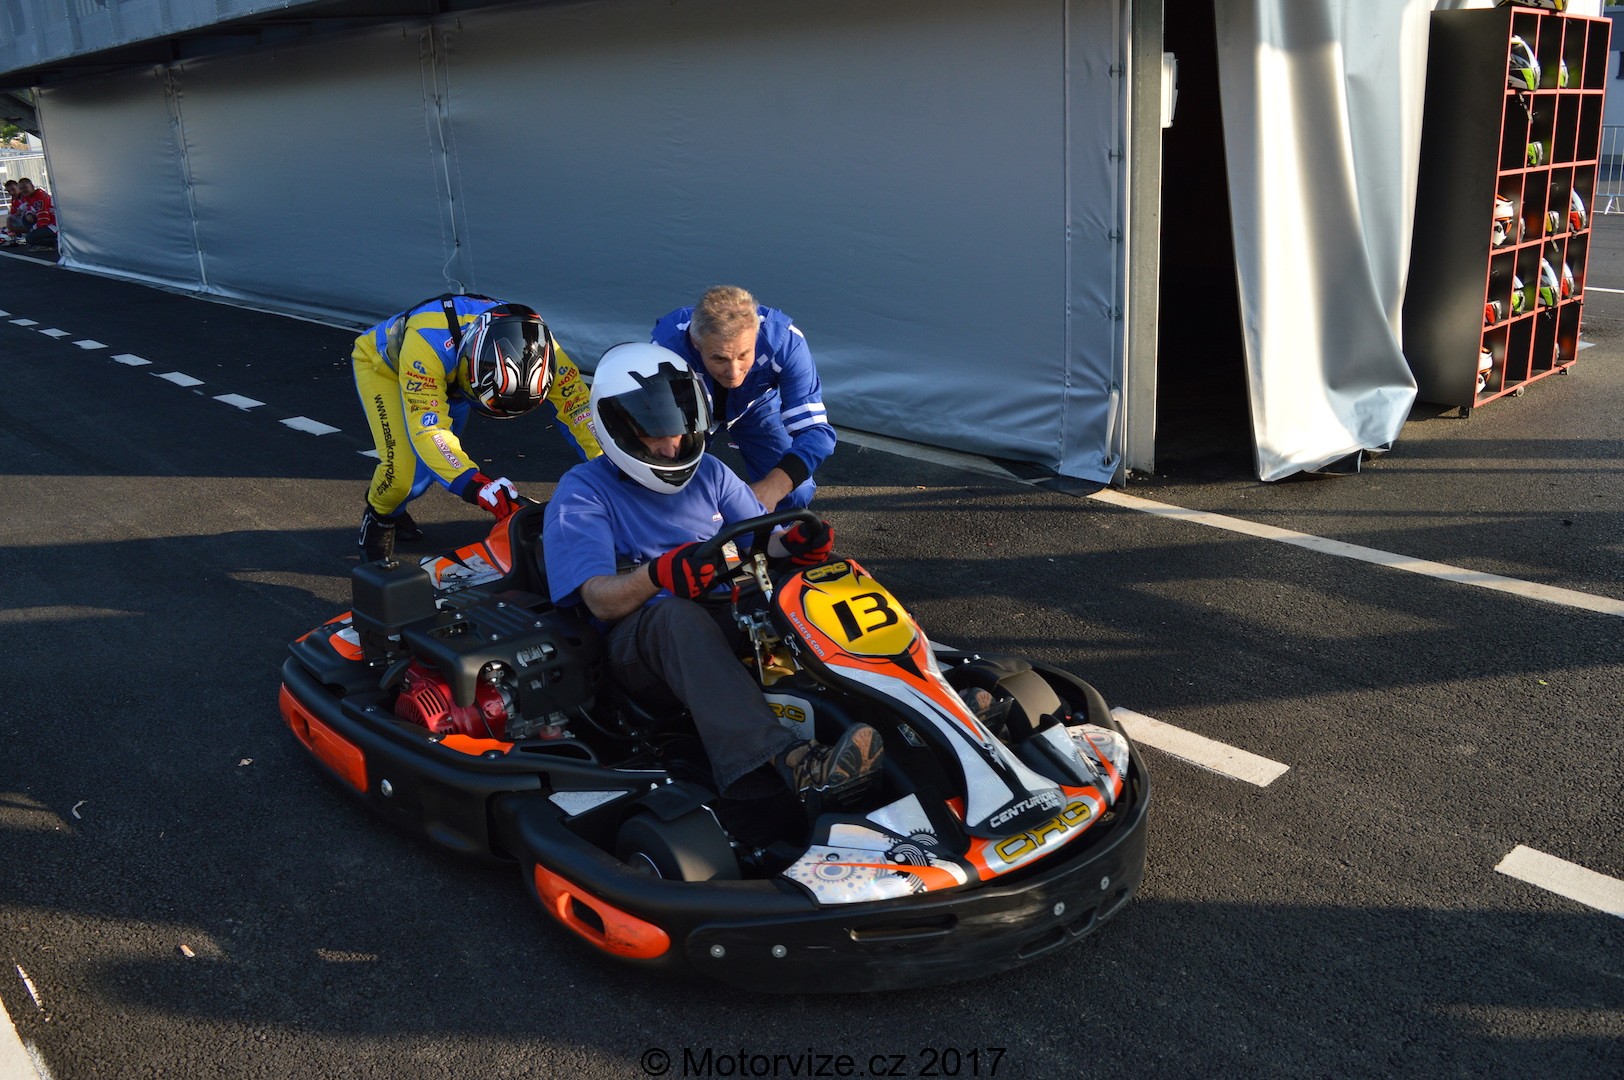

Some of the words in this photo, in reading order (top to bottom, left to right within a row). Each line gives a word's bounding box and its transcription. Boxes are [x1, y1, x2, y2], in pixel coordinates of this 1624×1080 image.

[805, 562, 848, 580] CRG
[789, 611, 825, 657] kartcrg.com
[832, 592, 898, 643] 13
[767, 703, 806, 722] RG
[989, 791, 1057, 828] CENTURION
[1040, 798, 1061, 812] LINE
[994, 801, 1091, 864] CRG
